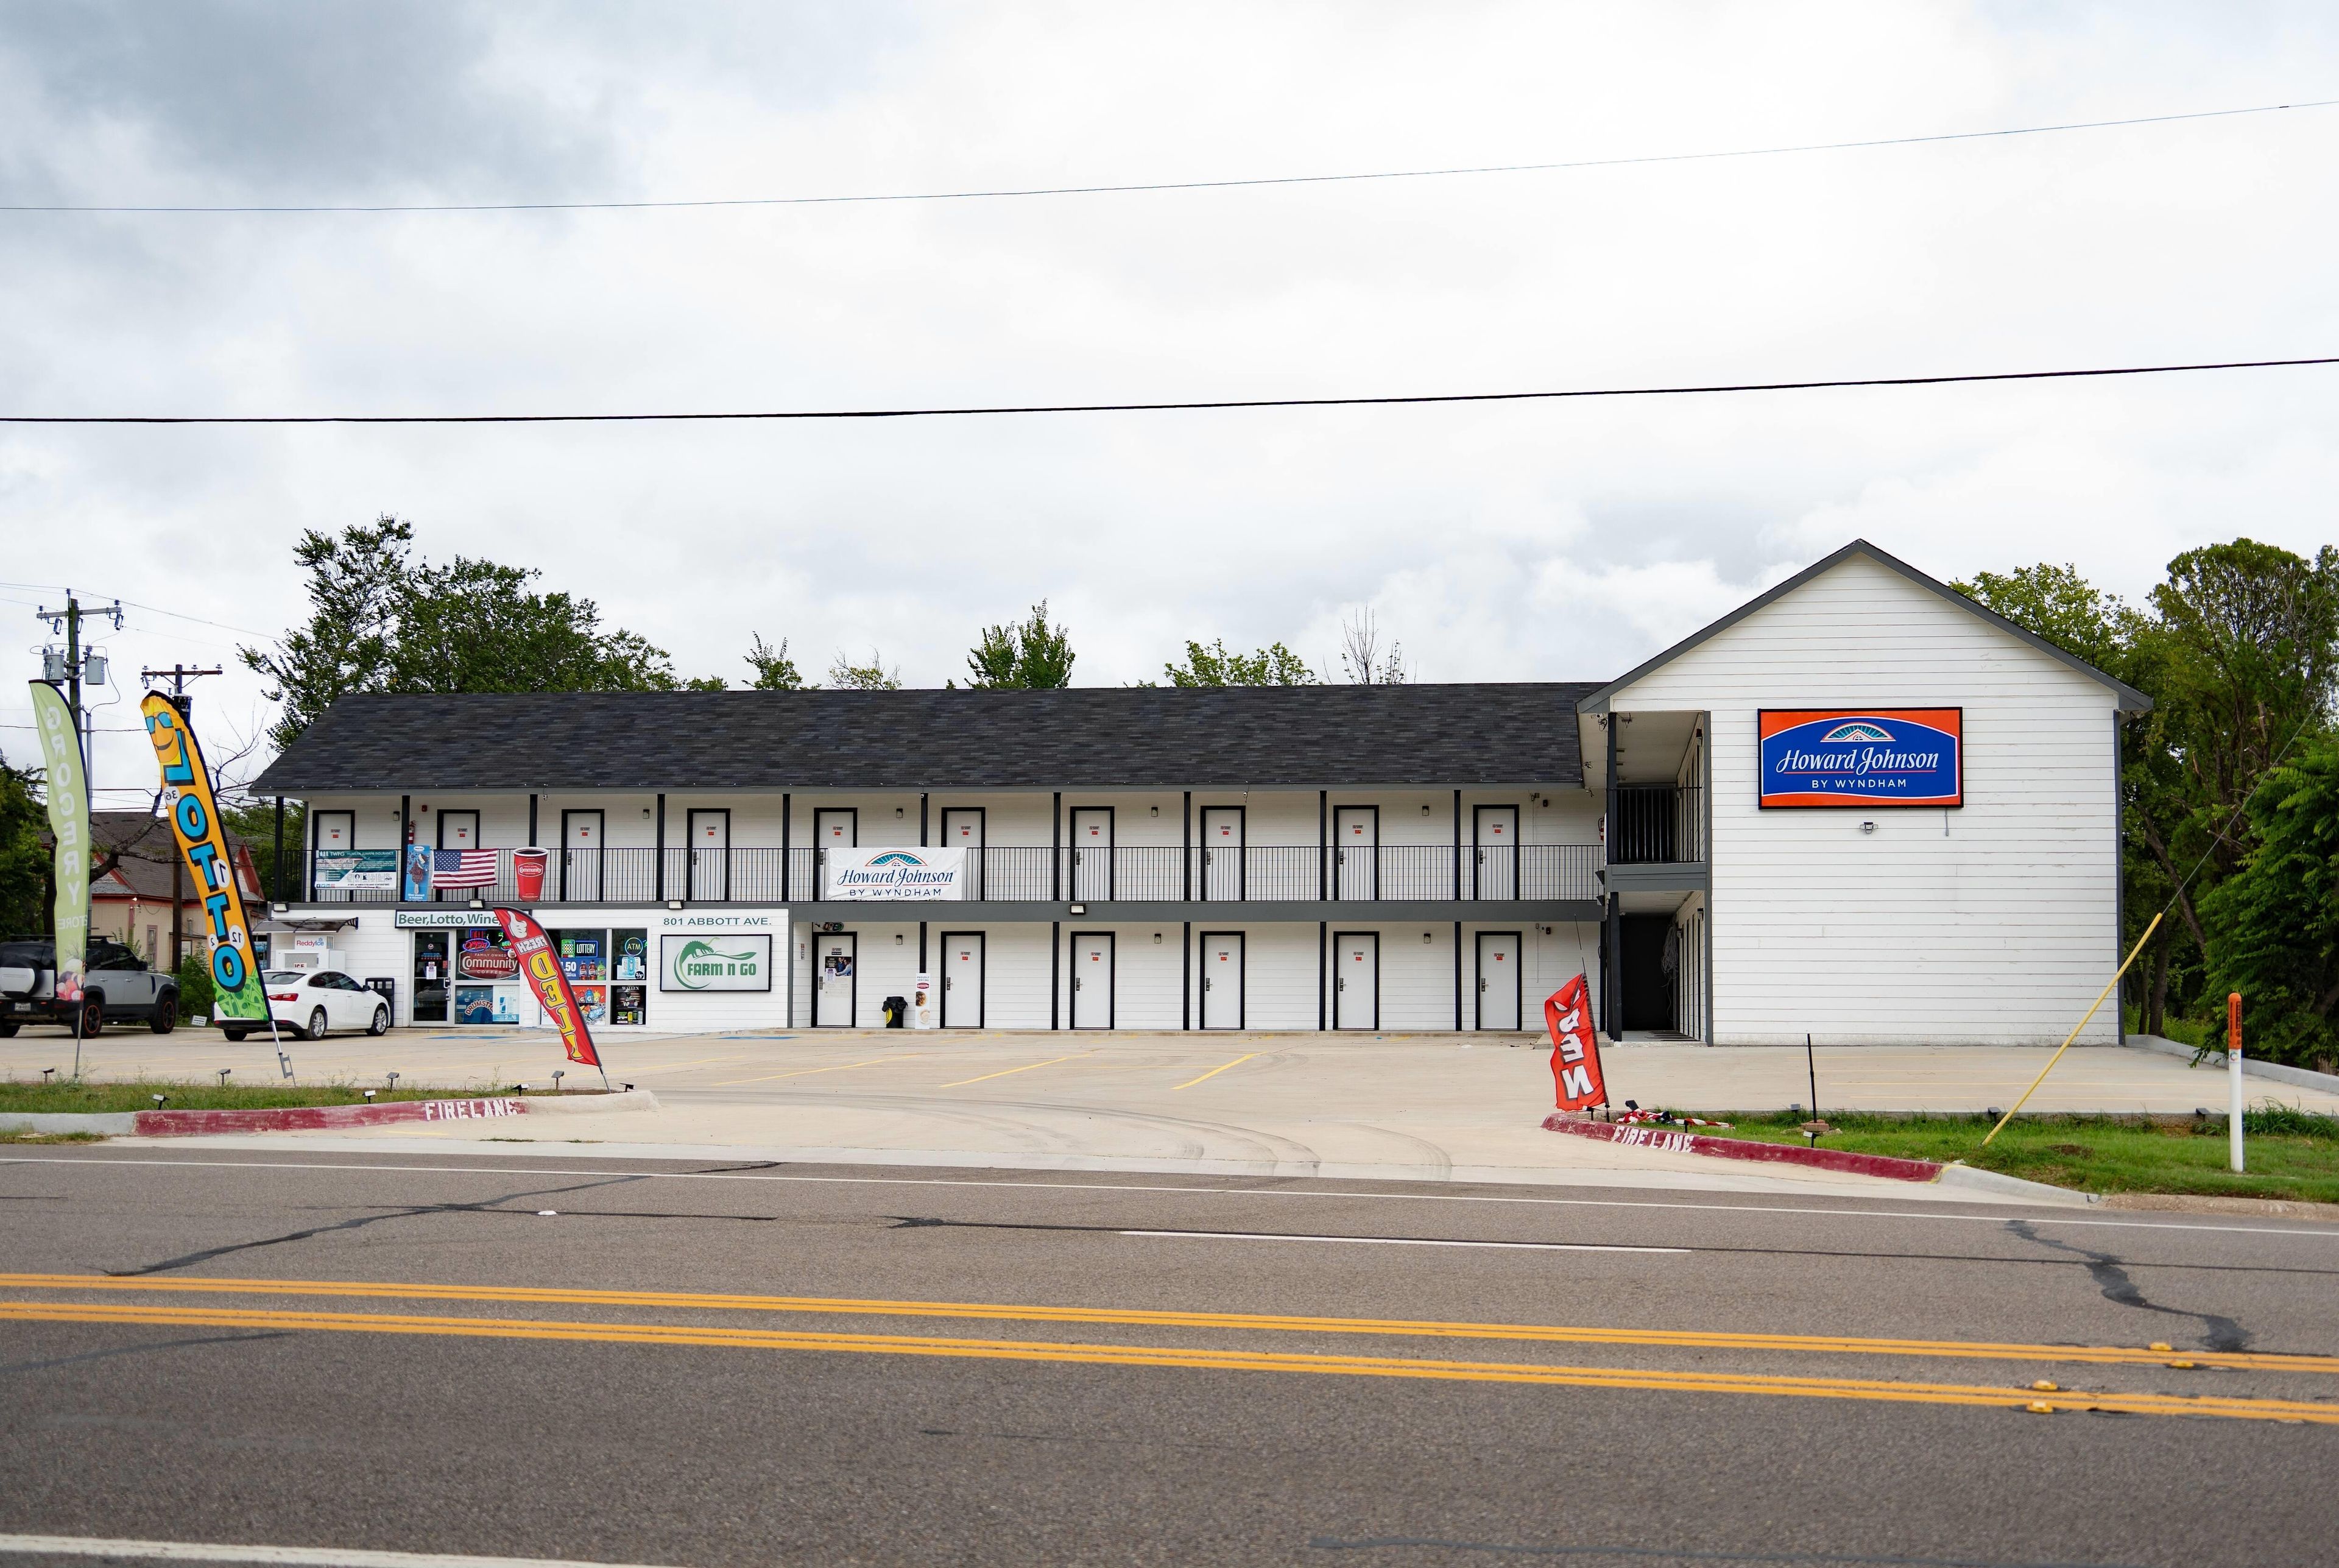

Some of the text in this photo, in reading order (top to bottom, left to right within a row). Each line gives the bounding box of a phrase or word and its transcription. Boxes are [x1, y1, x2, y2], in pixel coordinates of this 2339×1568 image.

[1776, 747, 1939, 775] Howard Johnson
[1812, 779, 1907, 788] BY WYNDHAM
[837, 867, 954, 888] Howard Johnson
[576, 944, 596, 954] LOTTERY
[462, 955, 518, 971] Community
[687, 963, 723, 976] FARM
[740, 963, 757, 976] GO
[1610, 1126, 1695, 1153] FIRE LANE
